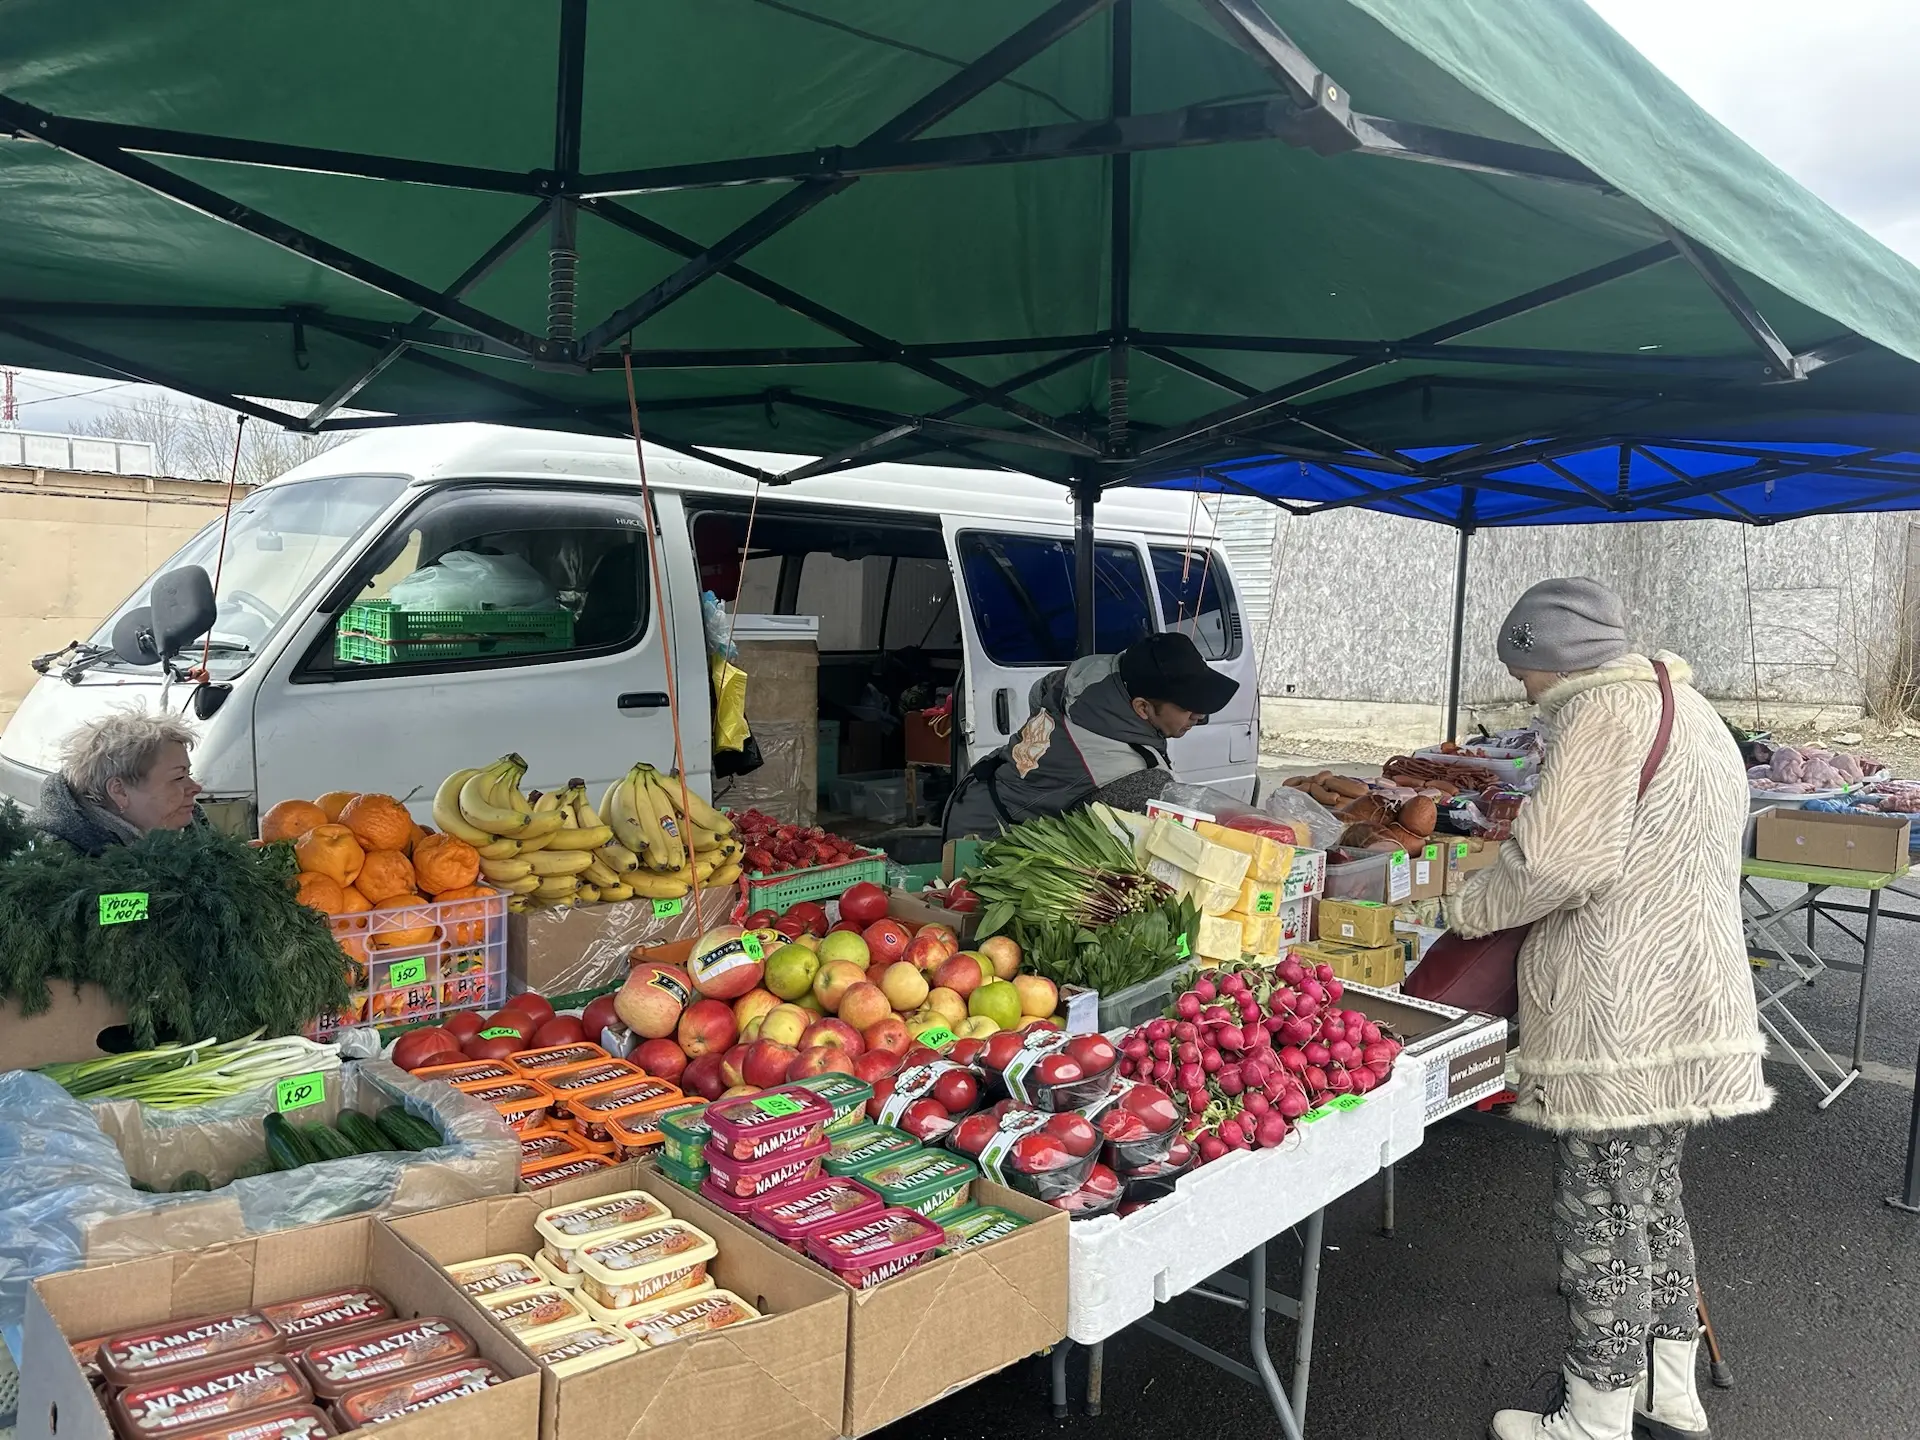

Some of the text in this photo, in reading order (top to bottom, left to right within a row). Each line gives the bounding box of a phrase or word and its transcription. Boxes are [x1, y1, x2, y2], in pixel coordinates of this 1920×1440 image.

[596, 1087, 665, 1111] NAMAZKA
[754, 1126, 806, 1158] NAMAZKA
[837, 1137, 902, 1165] NAMAZKA
[525, 1159, 600, 1186] NAMAZKA
[756, 1160, 807, 1195] NAMAZKA
[889, 1160, 957, 1190] NAMAZKA
[563, 1196, 643, 1226] NAMAZKA
[773, 1182, 849, 1217] NAMAZKA
[914, 1187, 956, 1216] AMAZKA
[600, 1226, 680, 1261] NAMAZKA
[828, 1214, 908, 1247] NAMAZKA
[634, 1265, 692, 1303] NAMAZKA
[861, 1253, 918, 1290] NAMAZKA
[282, 1302, 371, 1335] NAMAZK
[646, 1297, 727, 1335] NAMAZKA
[128, 1318, 250, 1357] NAMAZKA
[327, 1325, 440, 1367] NAMAZKA
[144, 1367, 275, 1414] NAMAZKA
